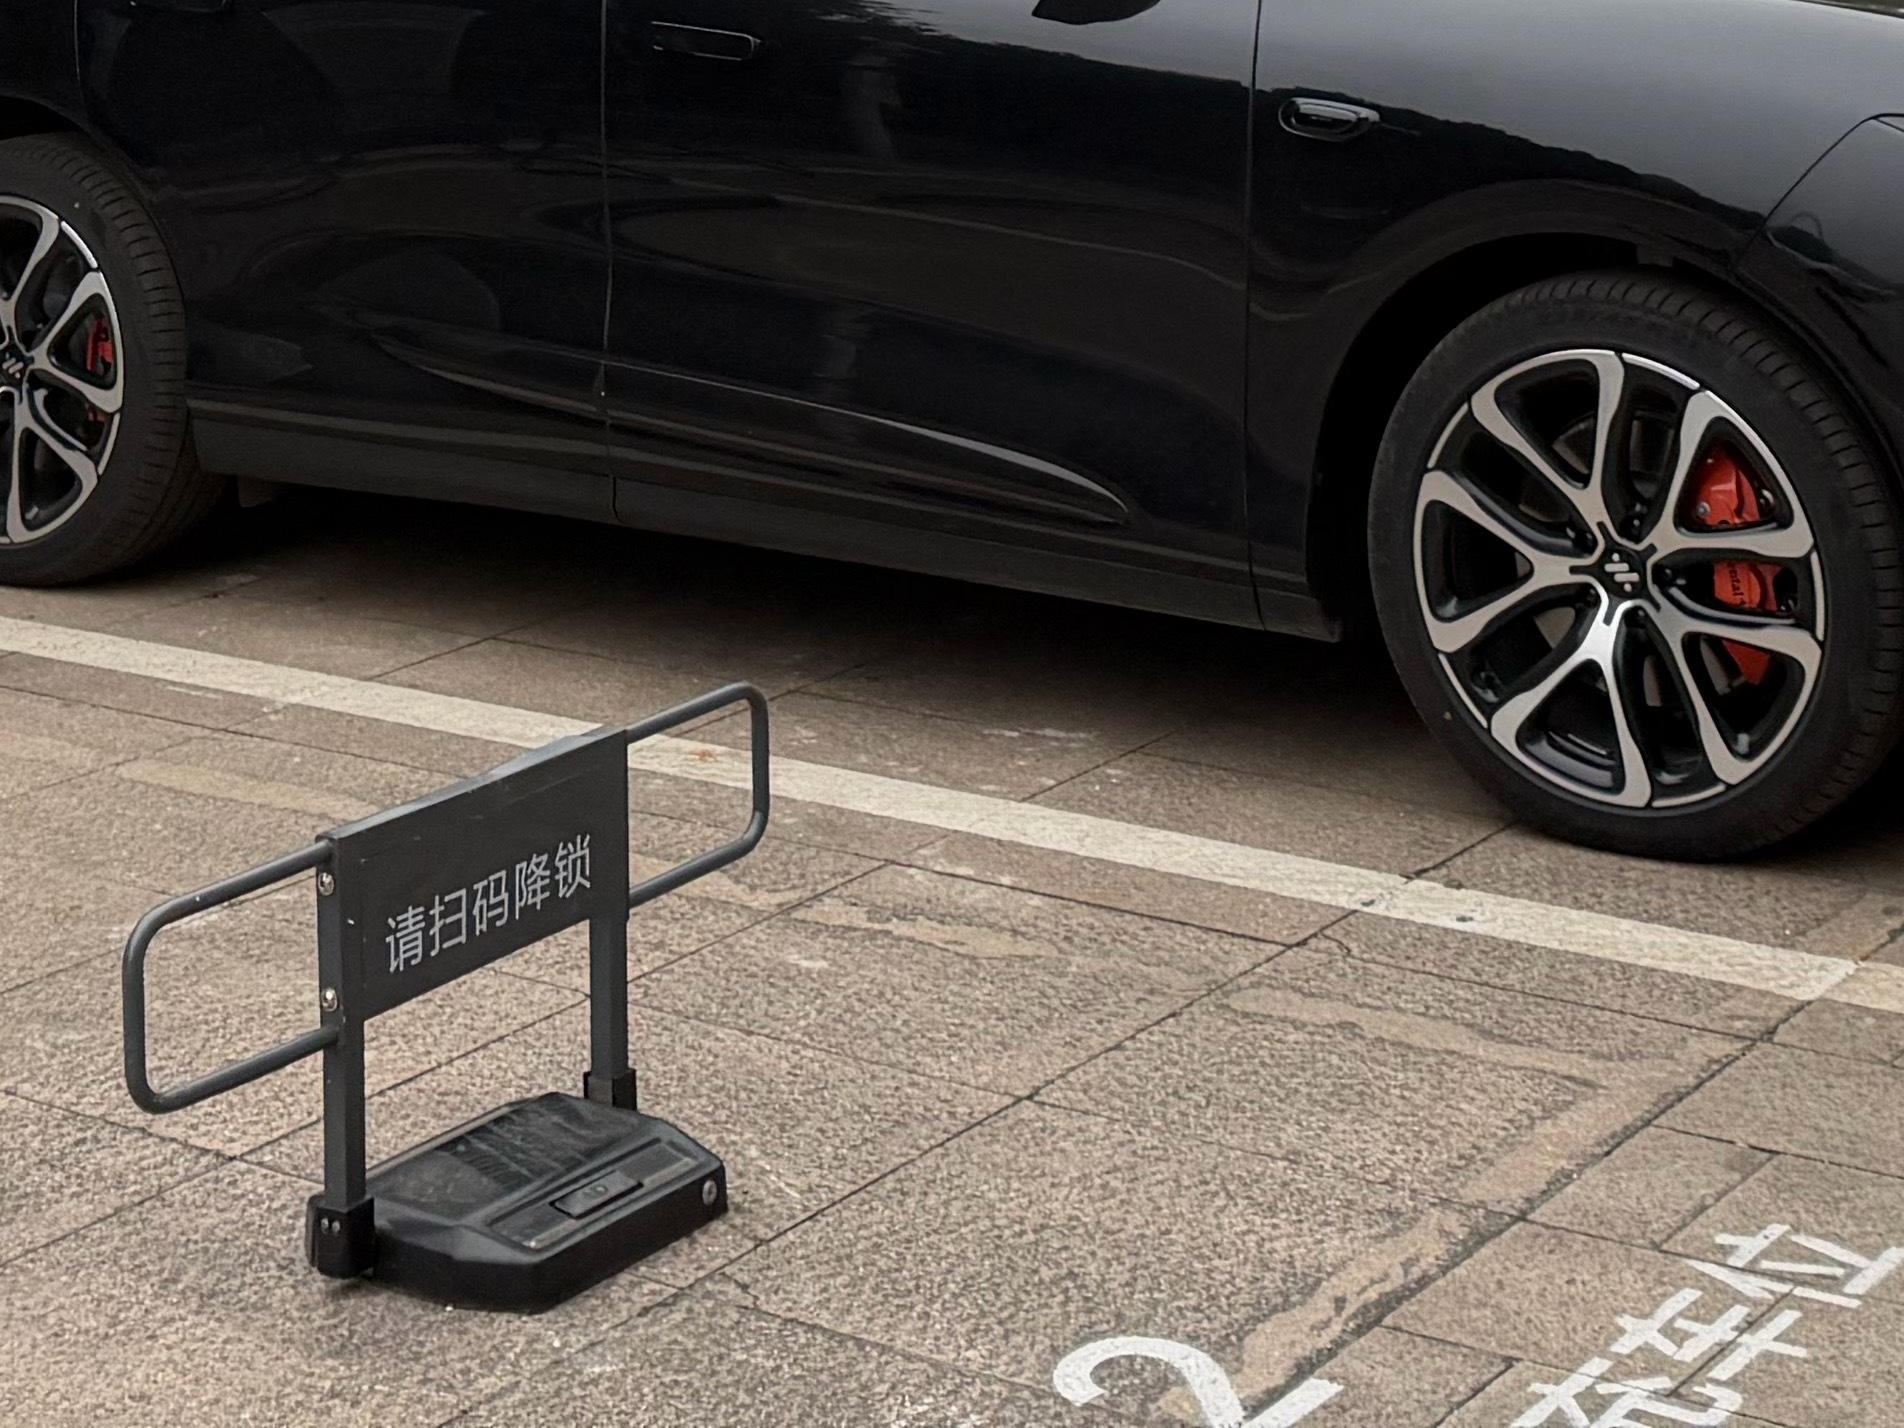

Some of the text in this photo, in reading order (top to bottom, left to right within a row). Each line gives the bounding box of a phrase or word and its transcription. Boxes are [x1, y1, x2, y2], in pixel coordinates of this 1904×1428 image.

[384, 832, 592, 975] 请扫码降锁
